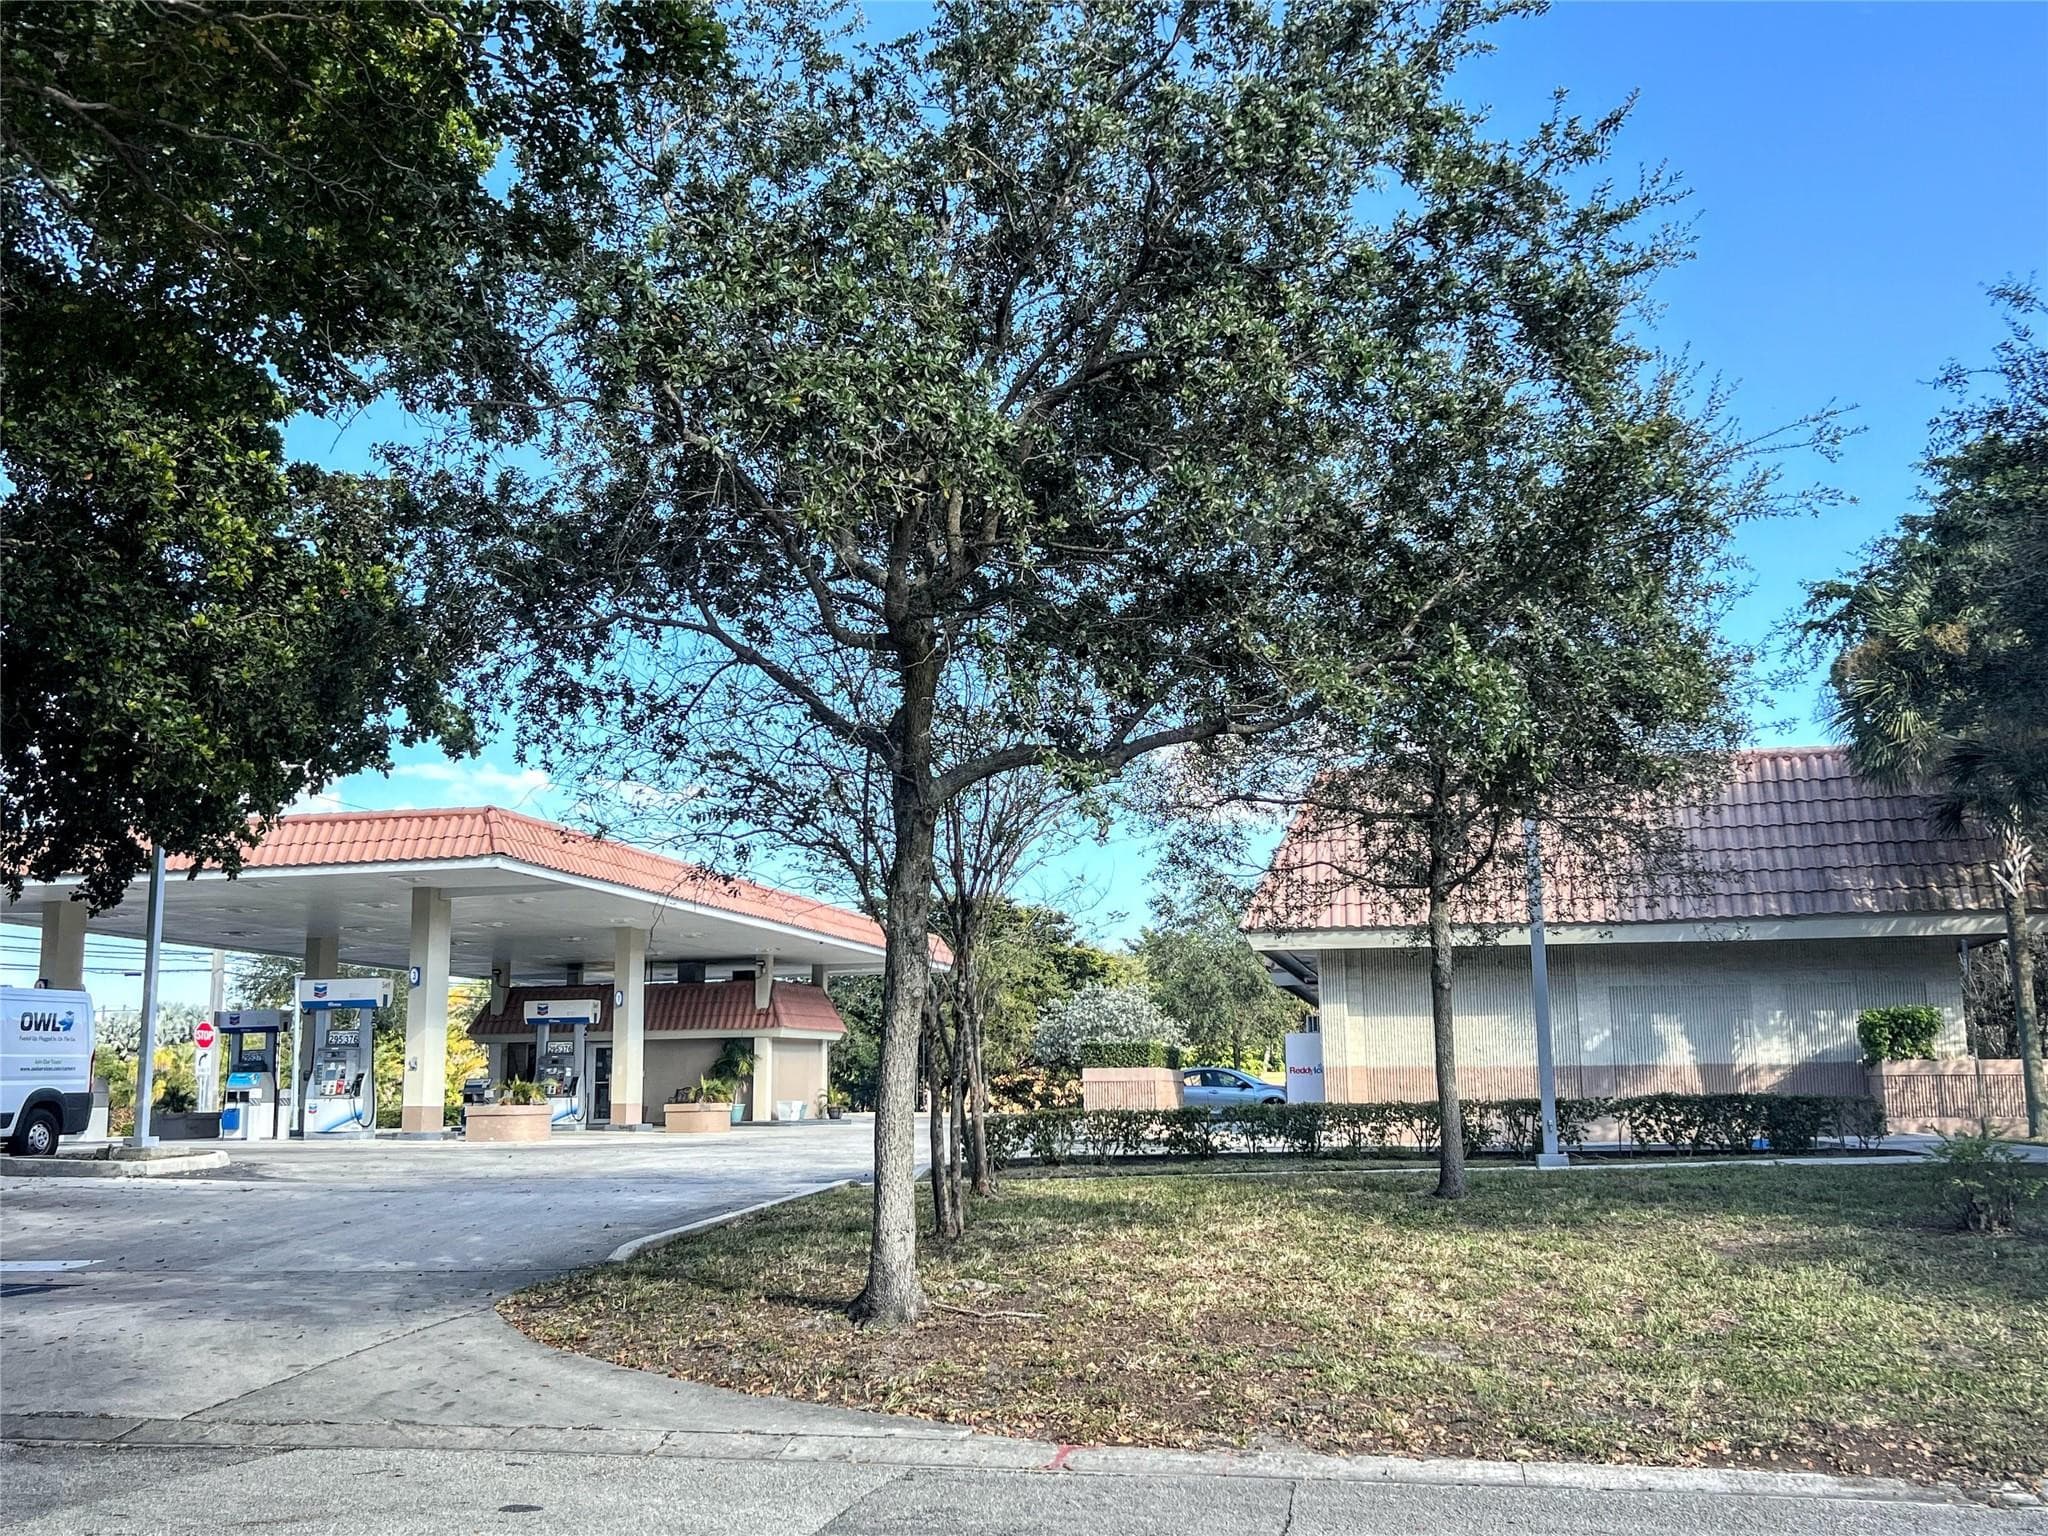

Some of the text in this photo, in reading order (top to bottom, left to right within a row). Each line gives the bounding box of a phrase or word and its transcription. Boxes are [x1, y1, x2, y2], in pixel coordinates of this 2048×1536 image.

[20, 1012, 60, 1031] OWL
[195, 1030, 214, 1041] STOP
[1289, 1066, 1312, 1075] Reddy
